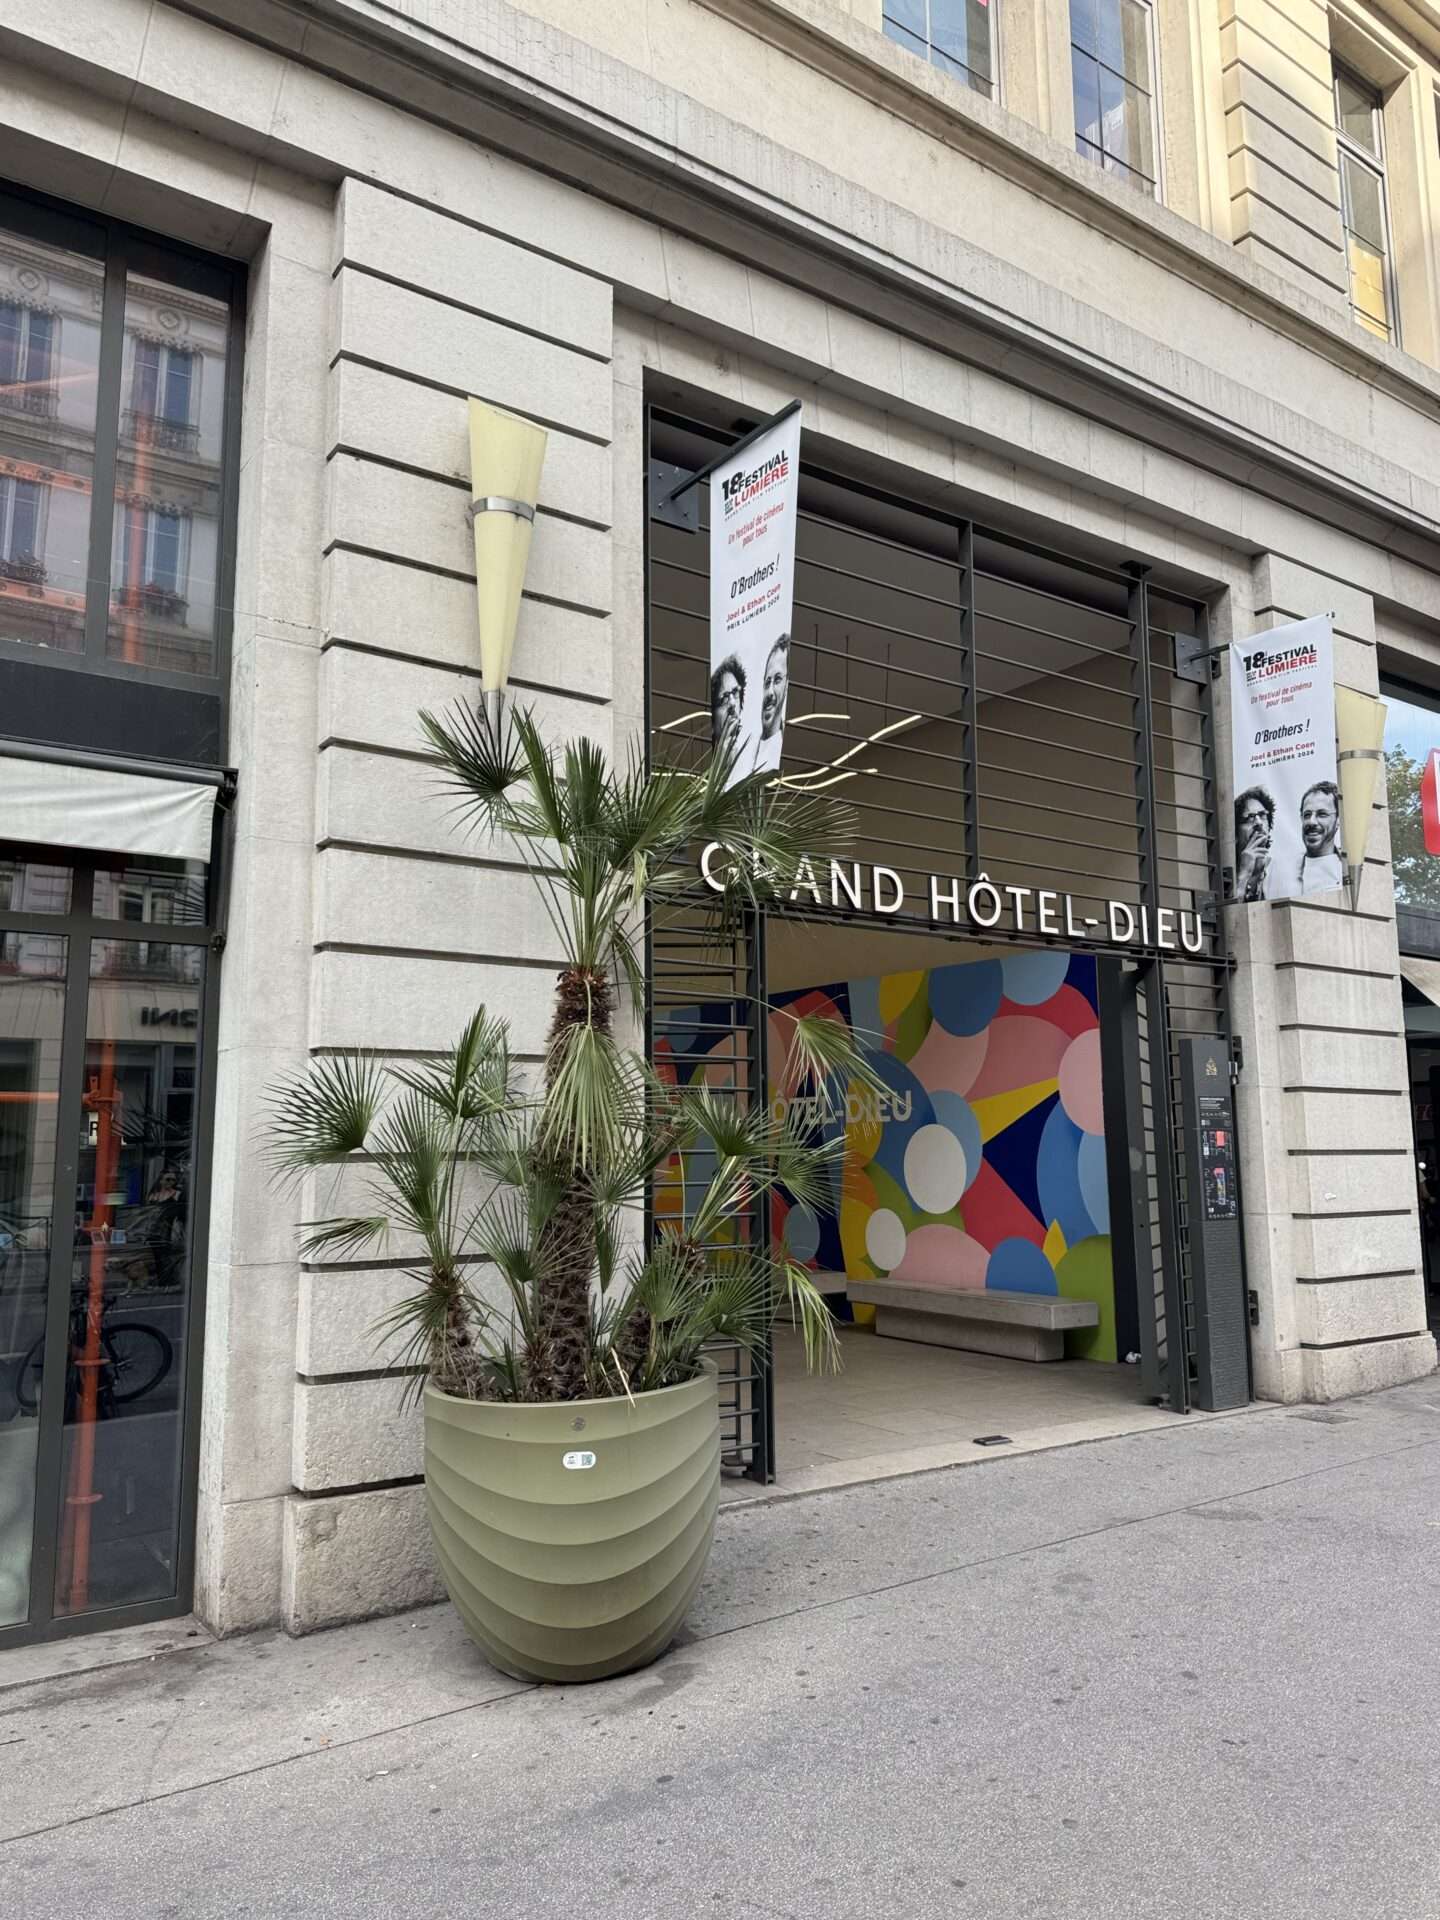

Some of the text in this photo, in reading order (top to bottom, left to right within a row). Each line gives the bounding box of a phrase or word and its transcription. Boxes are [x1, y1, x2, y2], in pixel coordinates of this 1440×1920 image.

[739, 449, 789, 493] FESTIVAL
[1261, 643, 1317, 668] FESTIVAL
[1273, 746, 1294, 756] Ethan
[1295, 741, 1315, 750] Coen
[1297, 749, 1315, 758] 2026
[930, 872, 1203, 953] HÔTEL-DIEU
